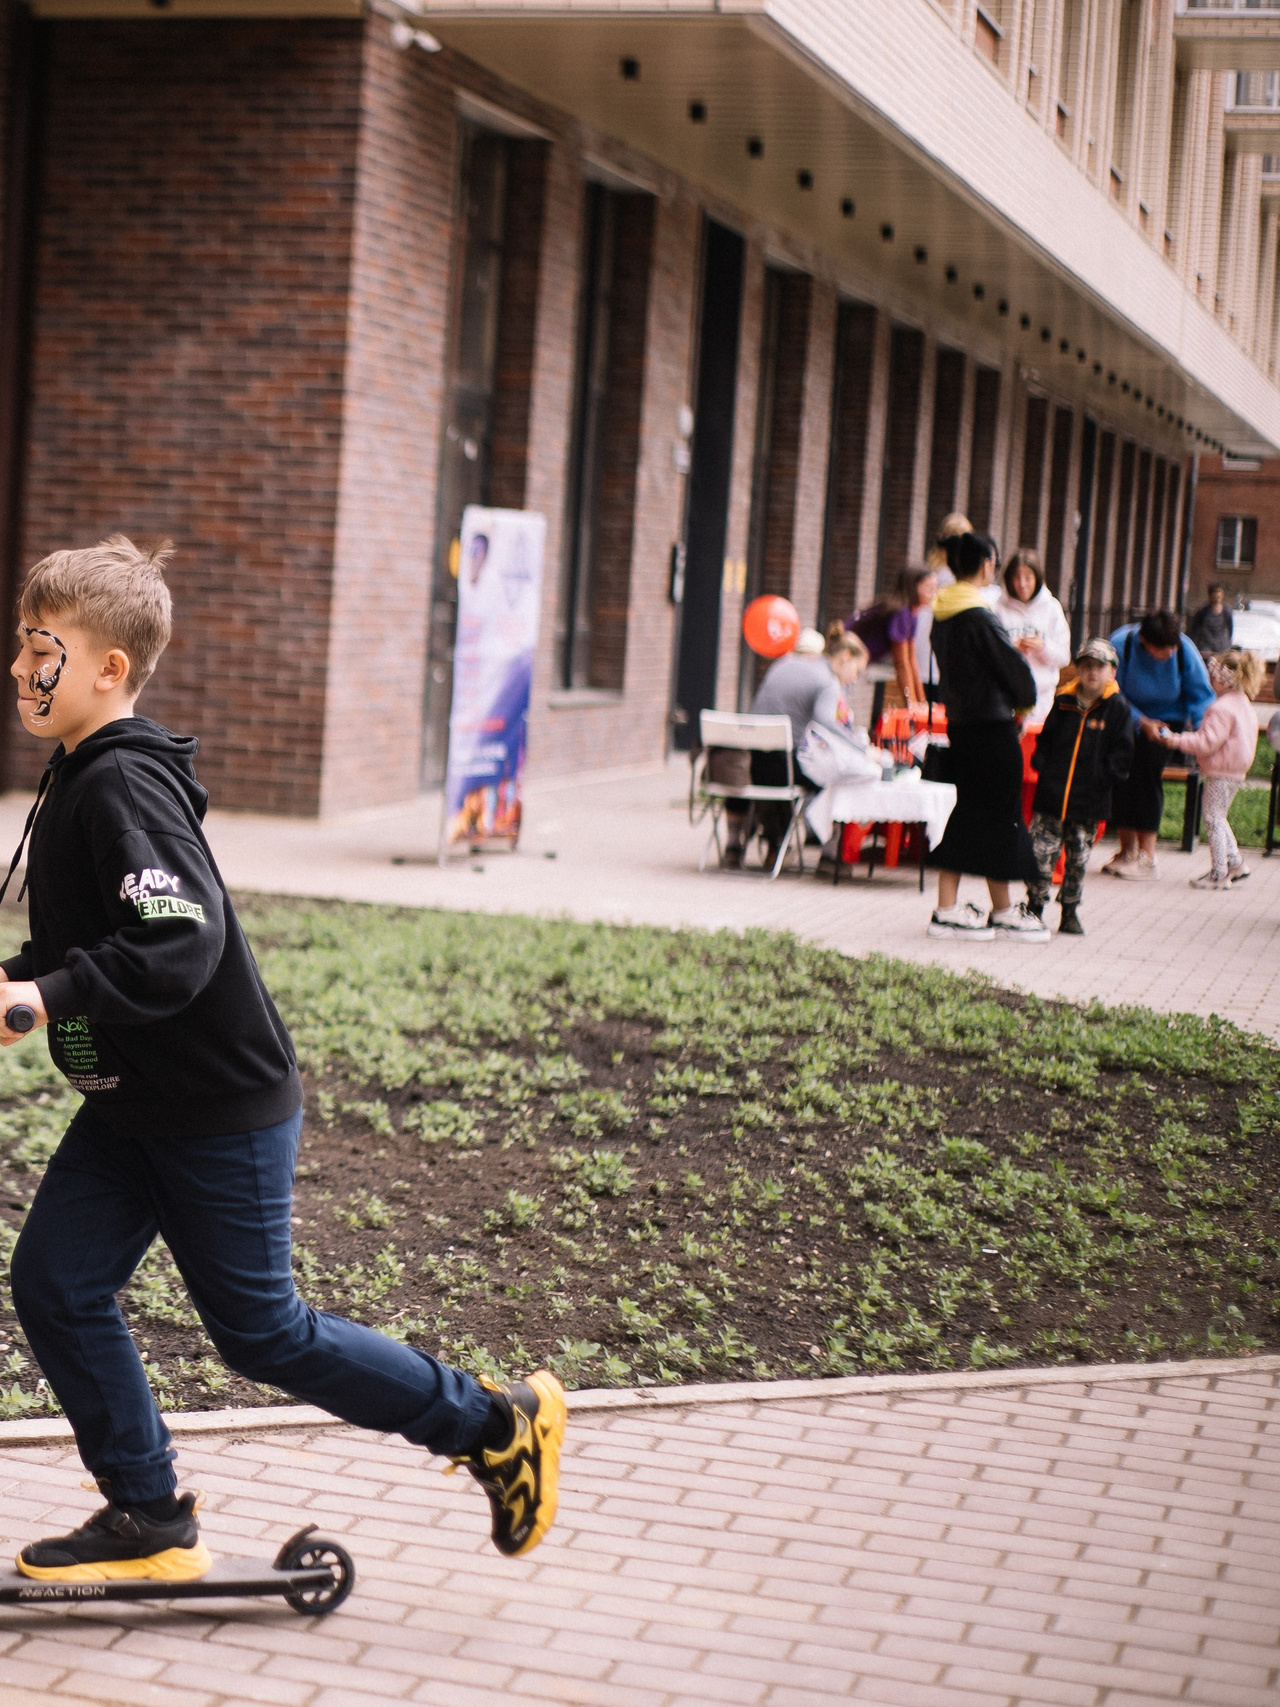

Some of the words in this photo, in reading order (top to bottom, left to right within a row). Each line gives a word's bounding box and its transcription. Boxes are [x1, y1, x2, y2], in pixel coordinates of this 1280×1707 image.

[130, 889, 150, 906] TO
[140, 899, 204, 921] EXPLORE
[78, 1076, 120, 1085] ADVENTURE
[85, 1082, 118, 1091] EXPLORE
[19, 1586, 106, 1598] REACTION
